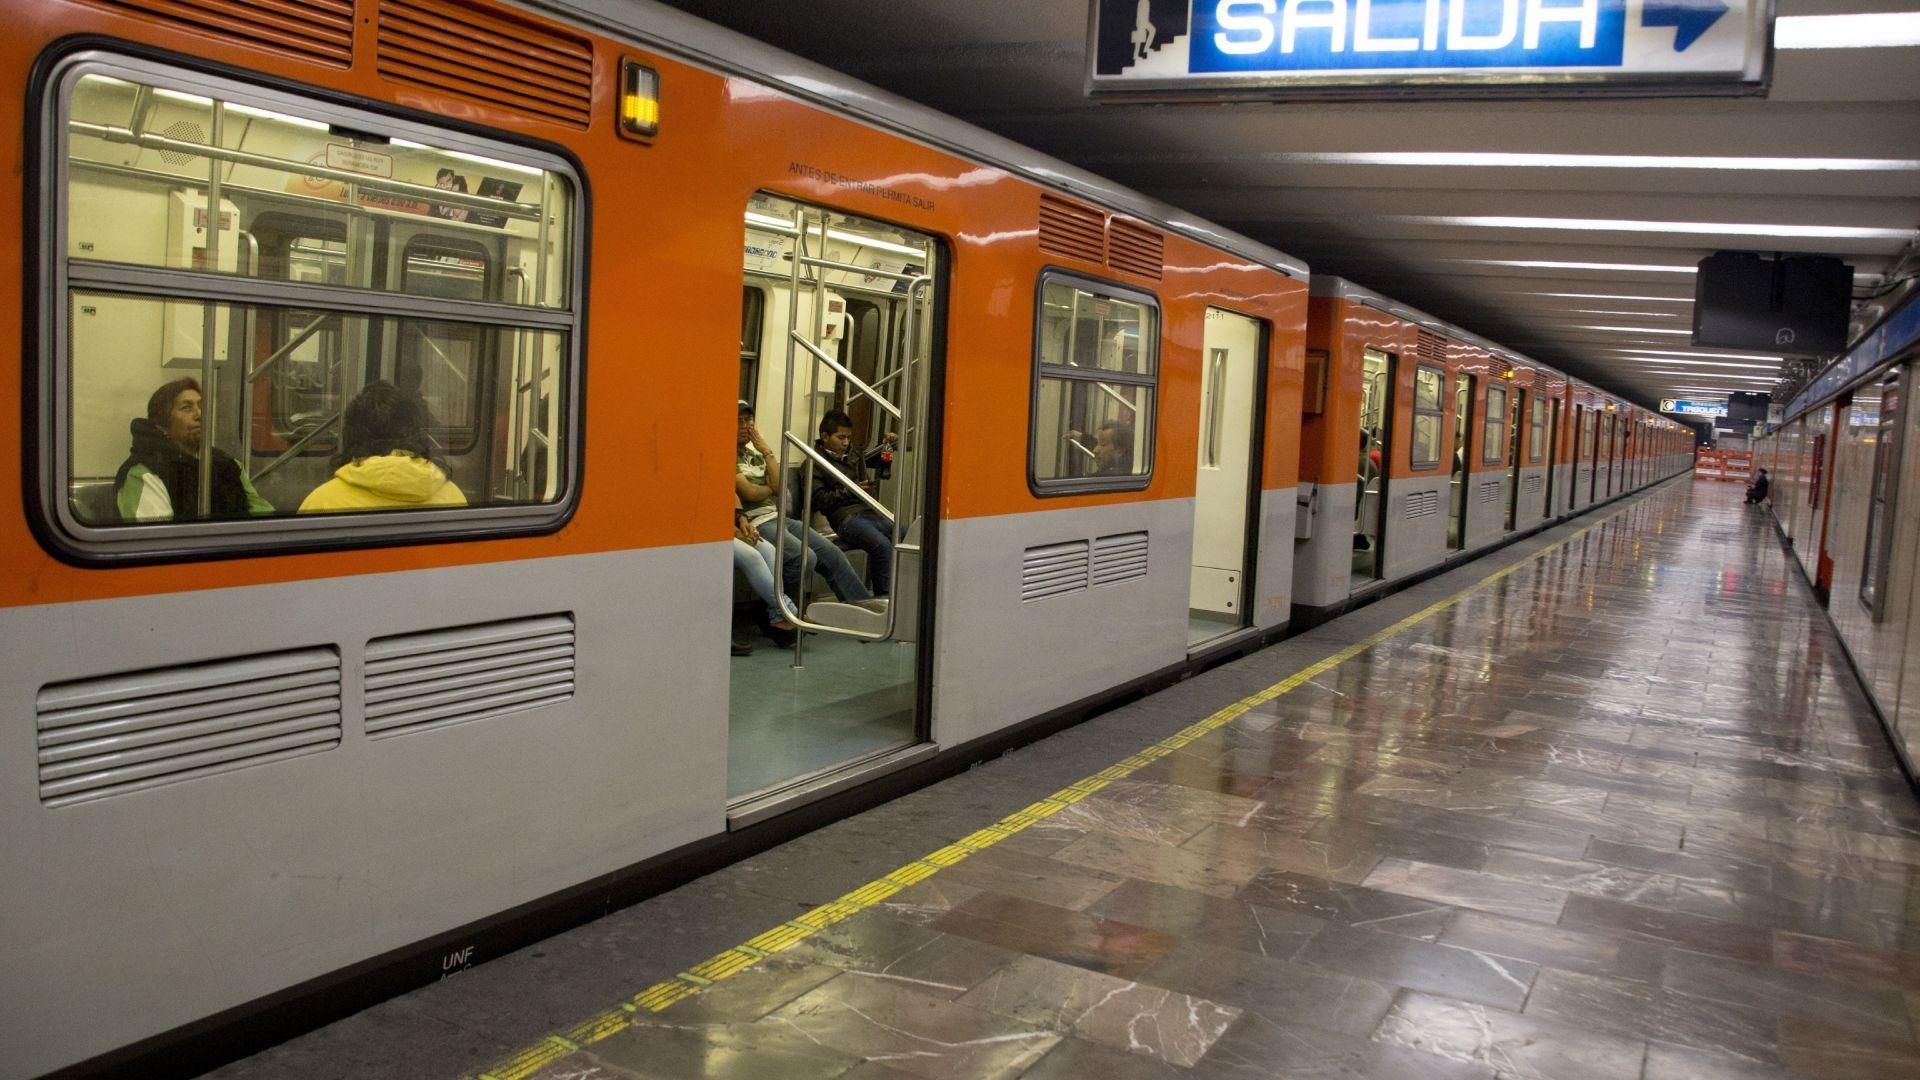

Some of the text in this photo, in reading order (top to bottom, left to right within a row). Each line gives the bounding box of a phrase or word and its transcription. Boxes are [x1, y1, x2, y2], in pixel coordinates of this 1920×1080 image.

[1213, 0, 1599, 55] SALIDA
[789, 162, 935, 212] ANTES DE ENTRAR PERMITA SALIR
[443, 946, 474, 969] UNF
